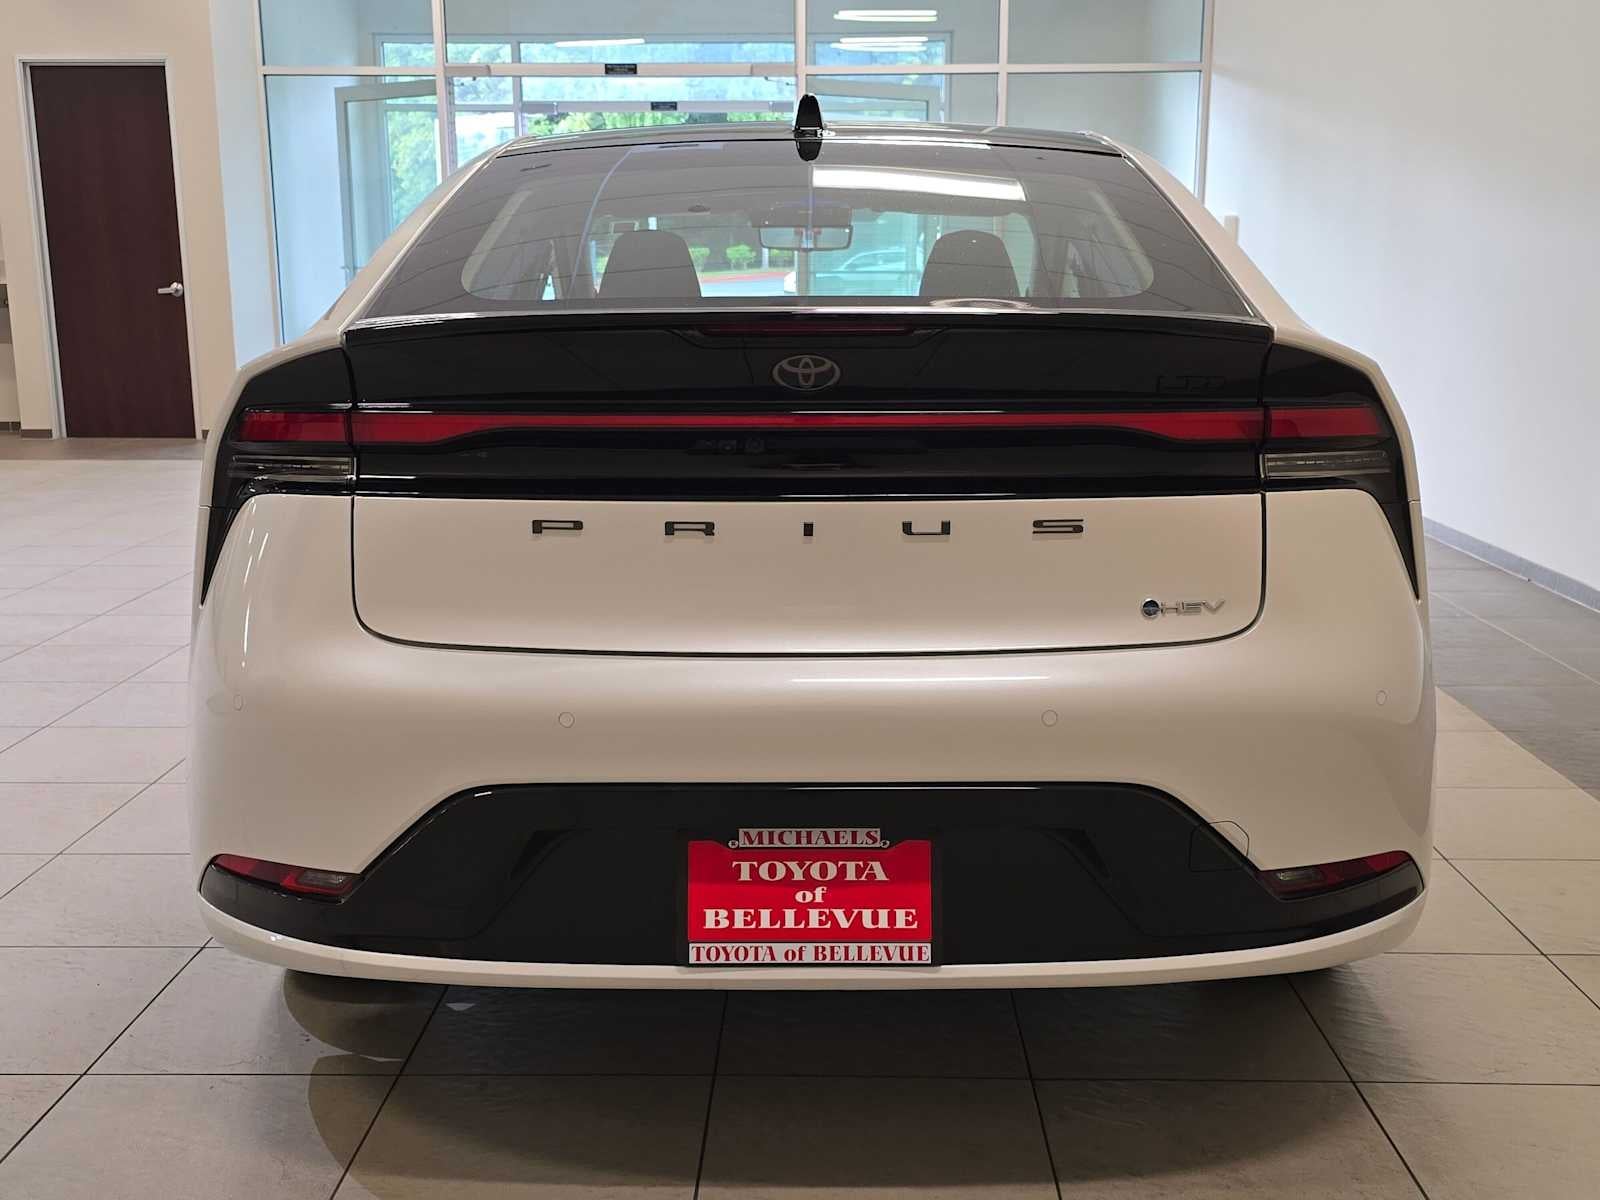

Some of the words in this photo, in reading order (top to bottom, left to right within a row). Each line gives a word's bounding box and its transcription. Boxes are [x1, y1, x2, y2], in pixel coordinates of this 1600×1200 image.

[532, 519, 1084, 537] PRIUS
[1160, 599, 1225, 616] HEV
[742, 830, 880, 846] MICHAELS
[732, 861, 889, 881] TOYOTA
[795, 886, 827, 903] of
[703, 908, 918, 929] BELLEVUE
[692, 945, 776, 962] TOYOTA
[784, 945, 806, 962] of
[814, 945, 929, 962] BELLEVUE
